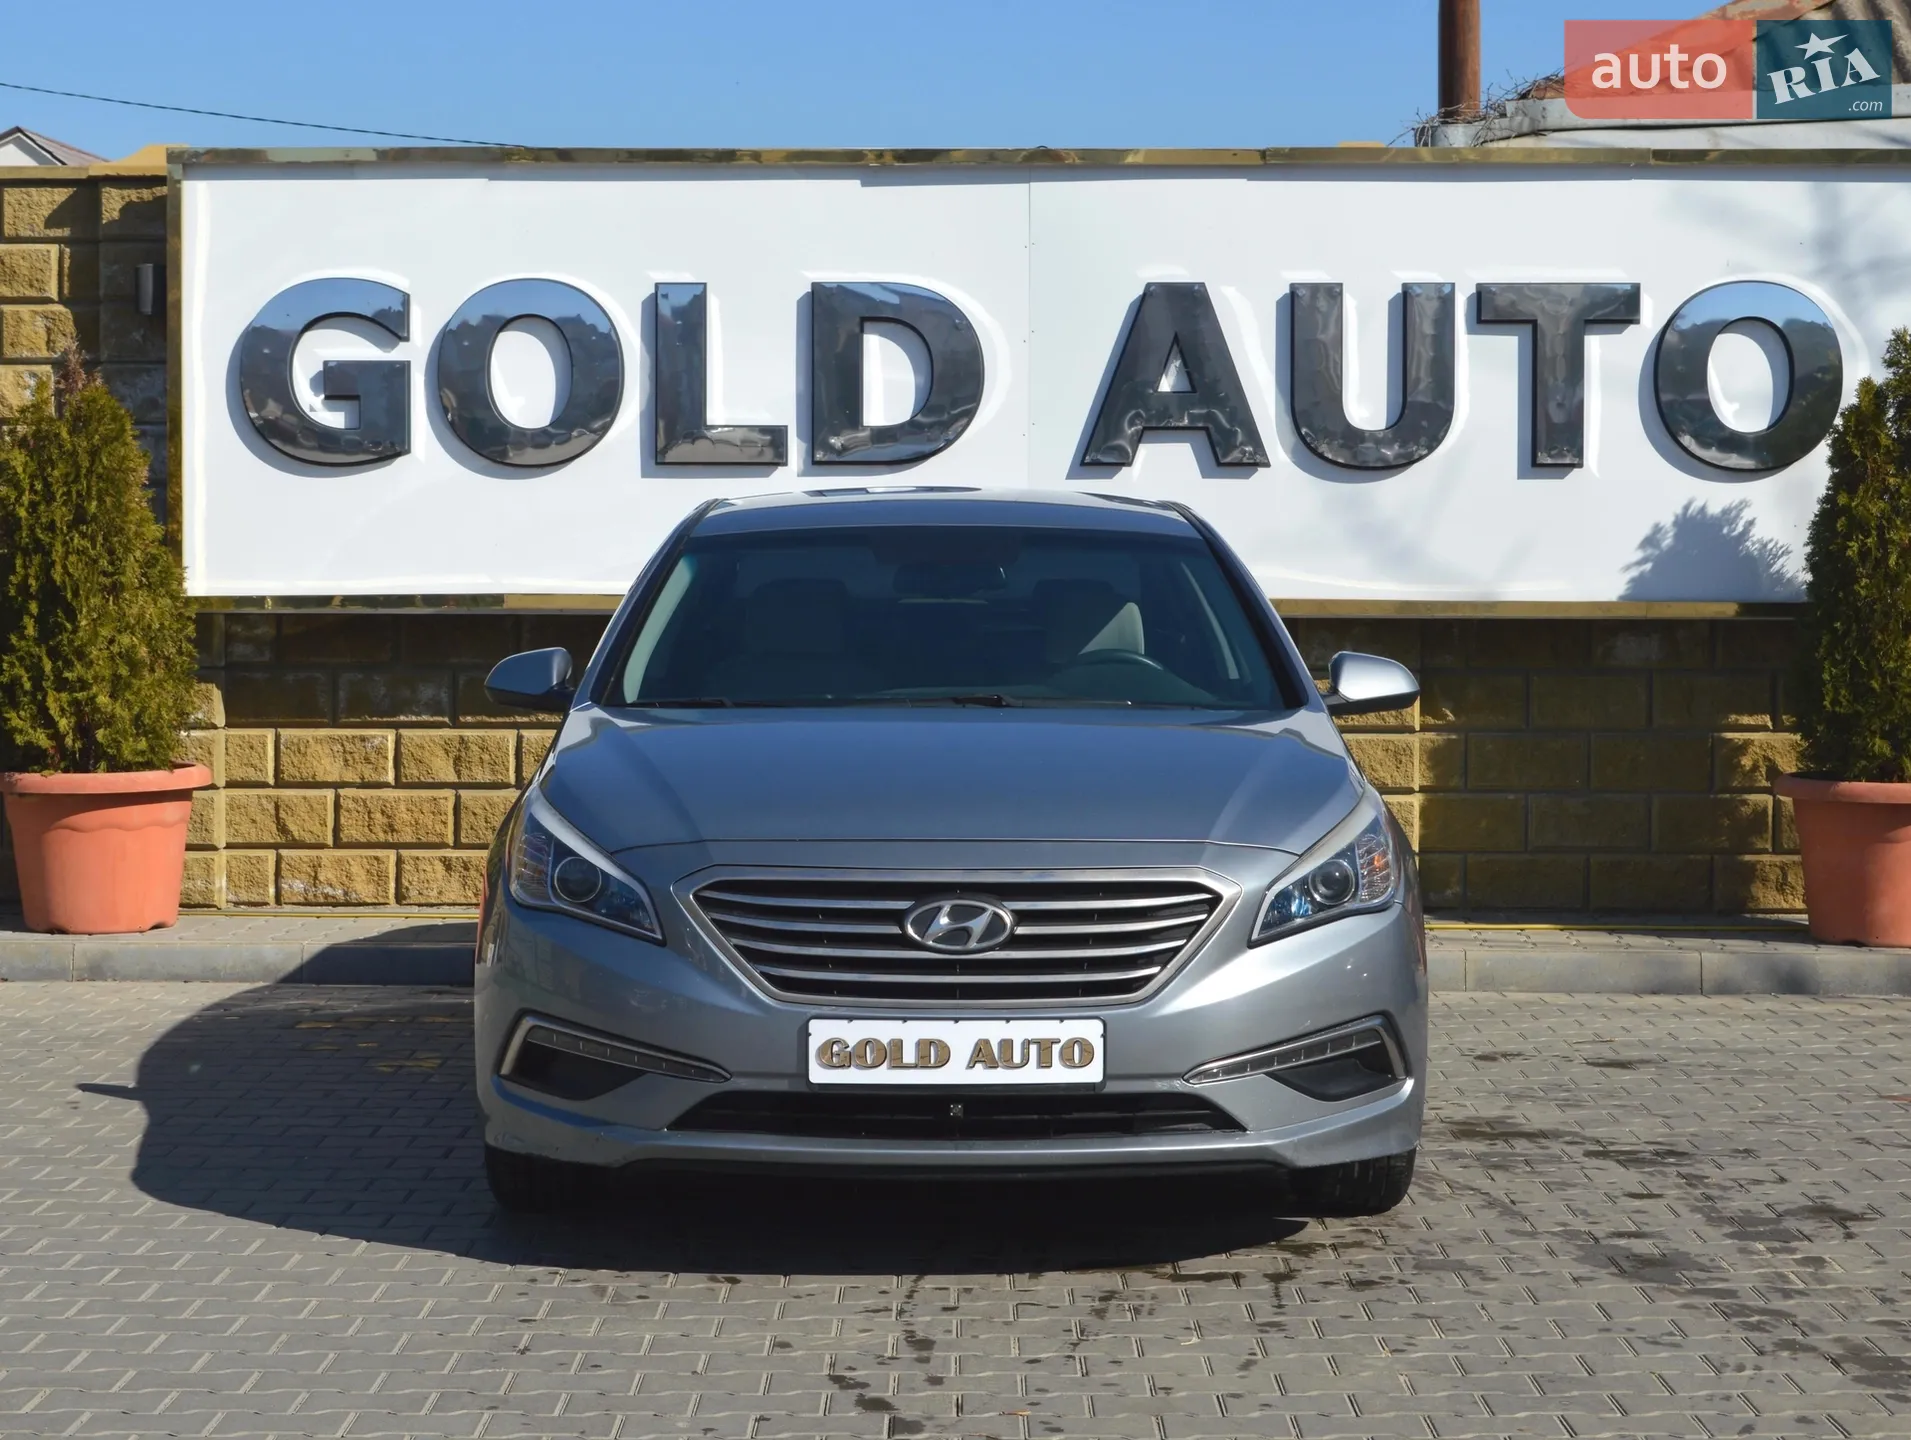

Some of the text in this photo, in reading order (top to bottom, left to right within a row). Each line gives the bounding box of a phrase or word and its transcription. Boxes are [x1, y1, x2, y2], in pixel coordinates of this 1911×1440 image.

[239, 277, 1844, 472] GOLD AUTO
[818, 1037, 1095, 1069] GOLD AUTO
